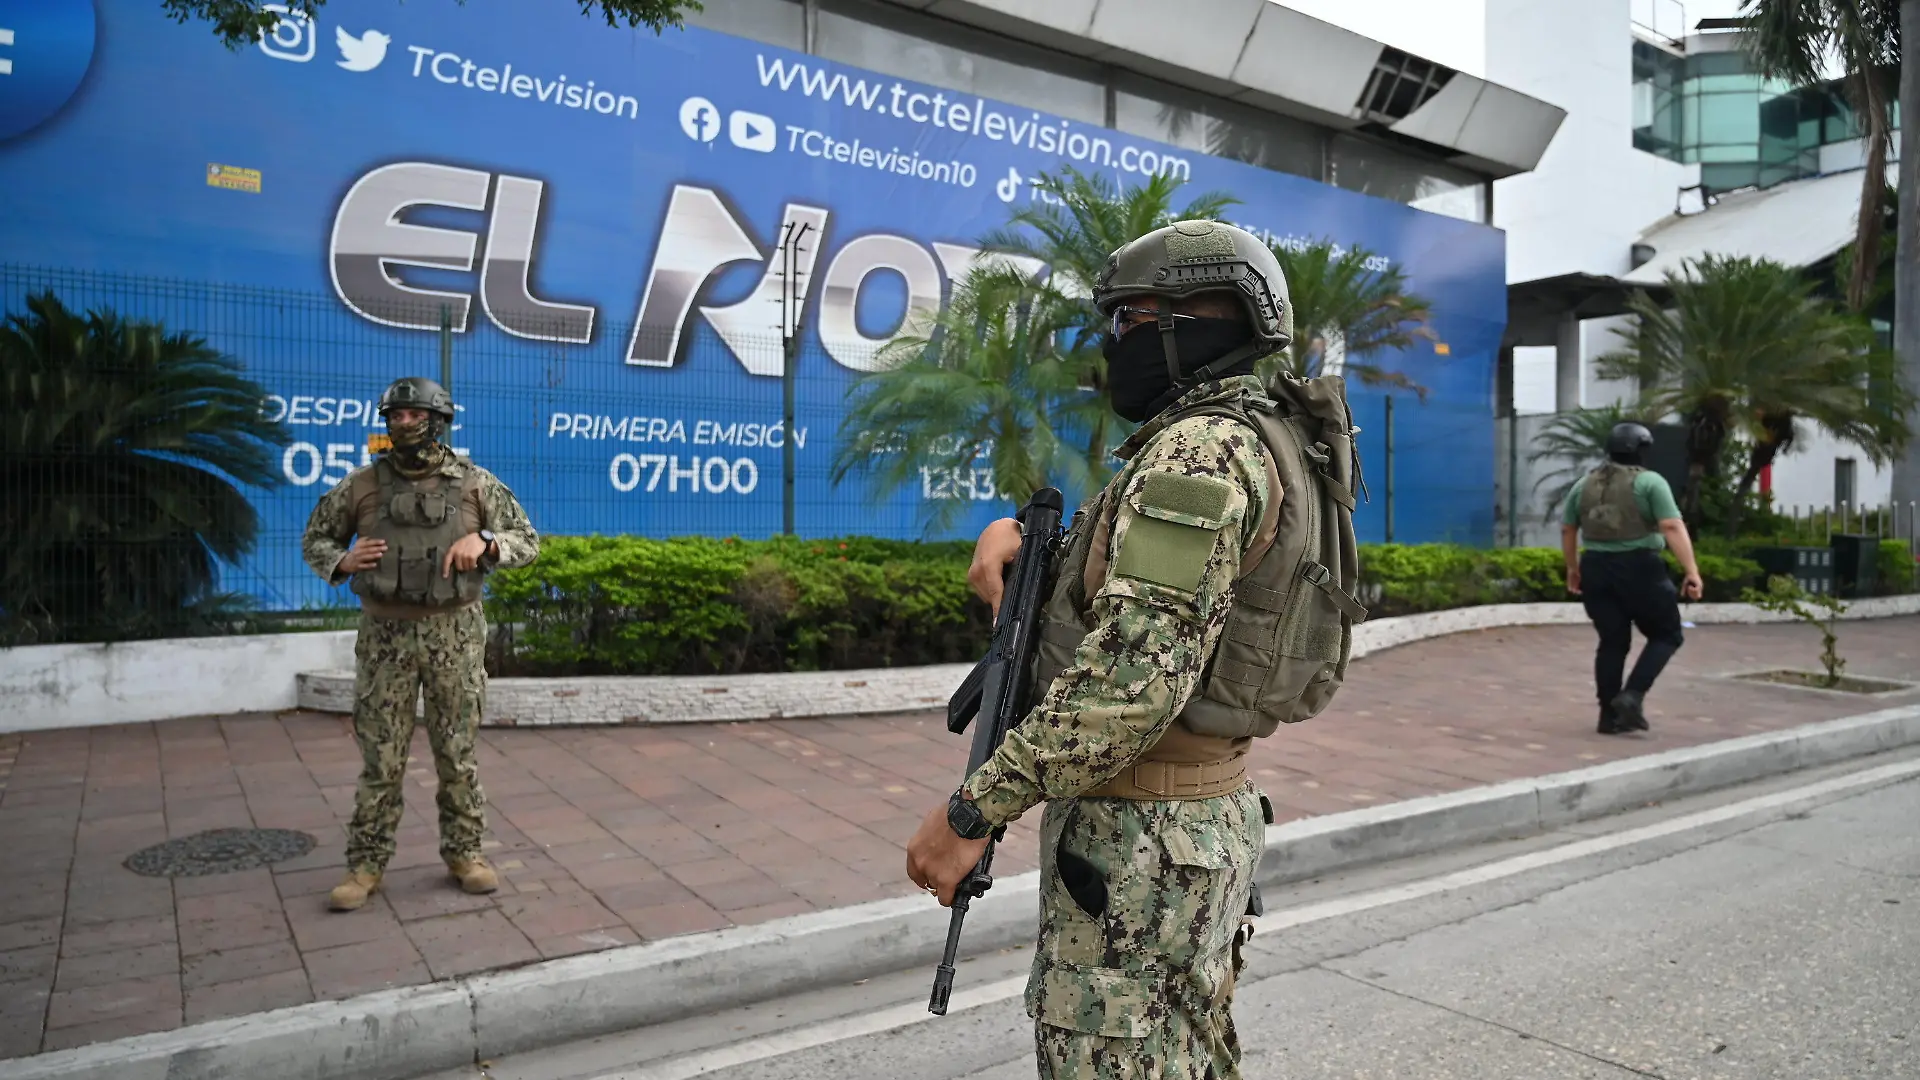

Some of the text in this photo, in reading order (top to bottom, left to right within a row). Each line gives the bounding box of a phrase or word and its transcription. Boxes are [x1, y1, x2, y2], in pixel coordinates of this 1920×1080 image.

[407, 45, 638, 119] TCtelevision
[756, 54, 1191, 184] www.tctelevision.com
[785, 125, 977, 188] TCtelevision10
[330, 161, 595, 344] EL
[548, 412, 687, 444] PRIMERA
[609, 452, 759, 495] 07H00
